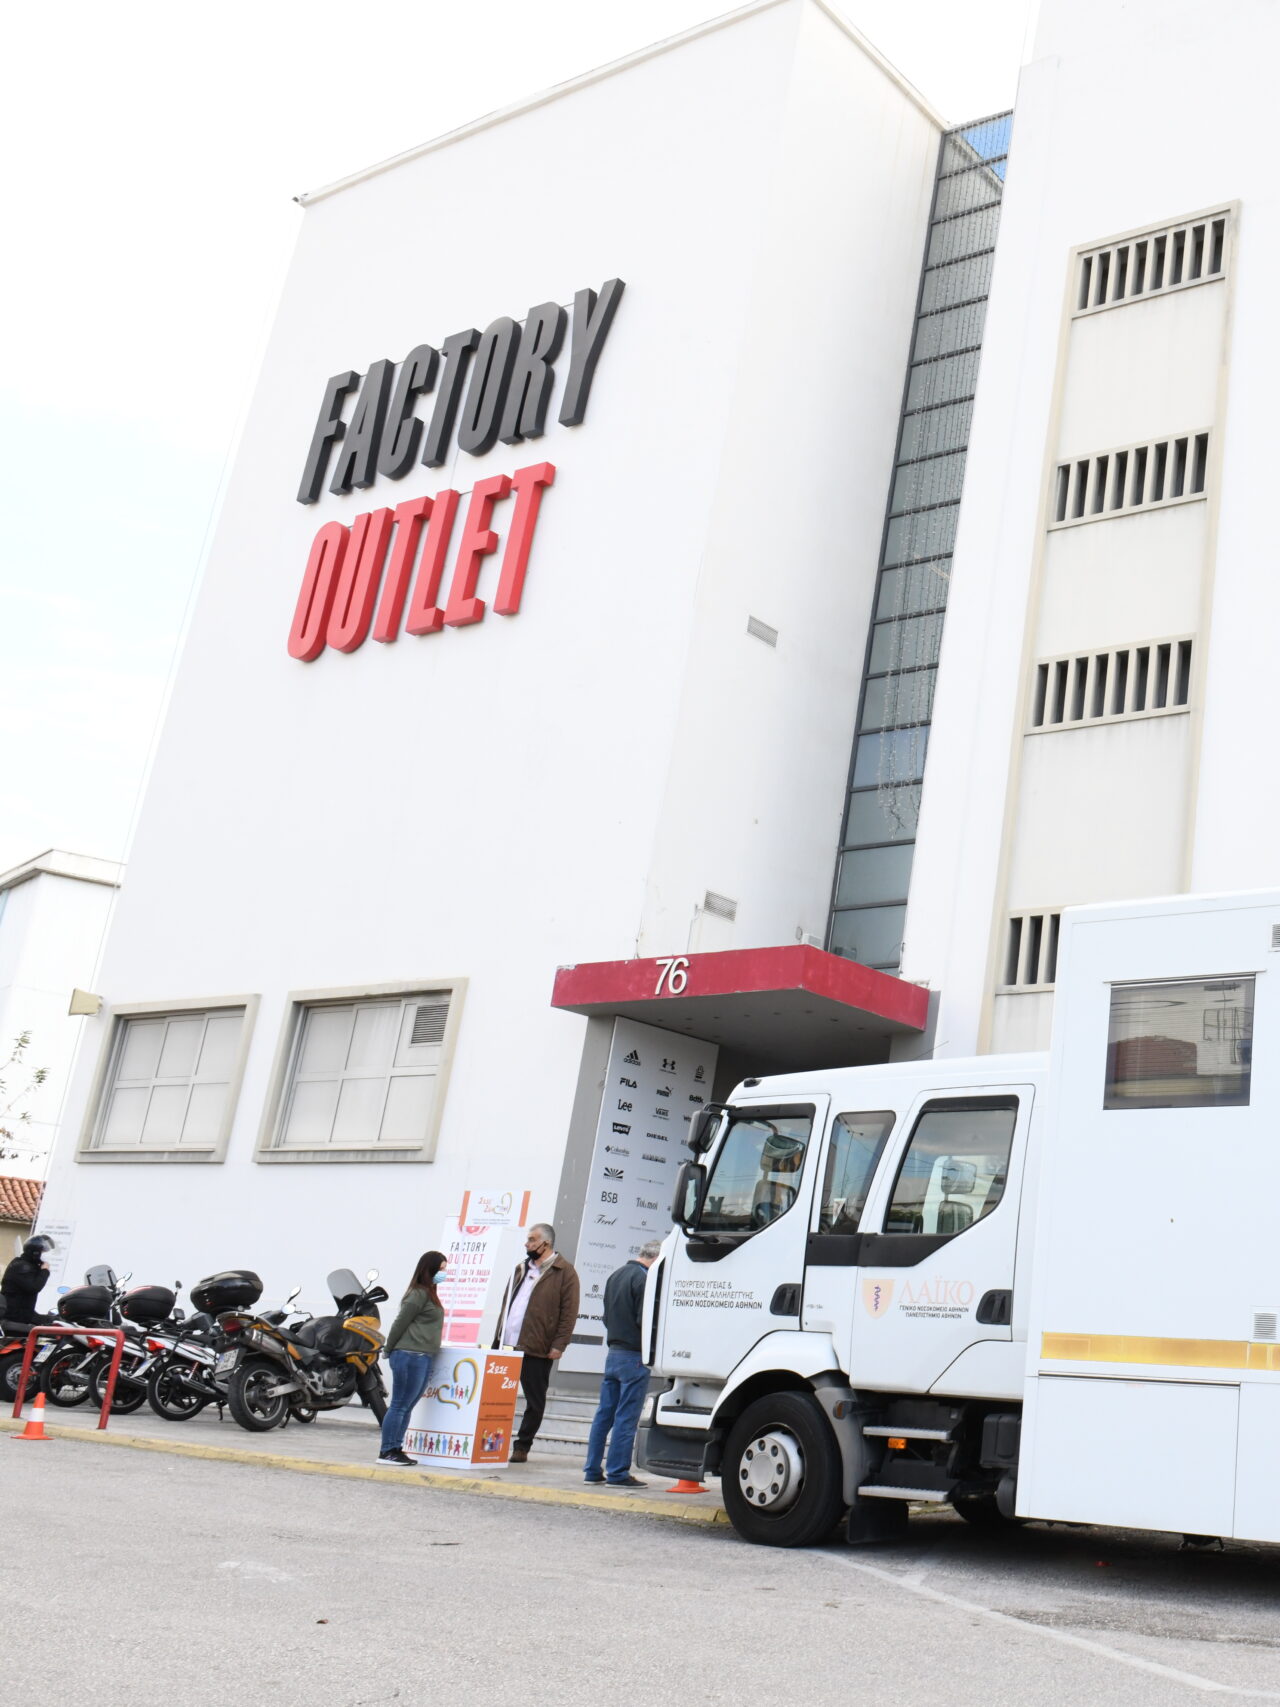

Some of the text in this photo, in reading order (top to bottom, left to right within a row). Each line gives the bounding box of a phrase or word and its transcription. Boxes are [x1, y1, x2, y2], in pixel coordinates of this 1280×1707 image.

[297, 277, 626, 505] FACTORY
[287, 462, 556, 663] OUTLET
[654, 957, 690, 995] 76
[619, 1077, 638, 1089] FILA
[618, 1098, 633, 1113] Lee
[646, 1132, 669, 1142] DIESEL
[601, 1191, 618, 1204] BSB
[447, 1253, 485, 1265] OUTLET
[674, 1280, 705, 1289] ΥΠΟΥΡΓΕΙΟ
[706, 1281, 727, 1289] ΥΓΕΙΑΣ
[898, 1275, 975, 1305] ΛΑΪΚΟ
[673, 1289, 754, 1300] ΚΟΙΝΩΝΙΚΗΣ ΑΛΛΗΛΕΓΓΥΗΣ
[672, 1299, 763, 1309] ΓΕΝΙΚΟ ΝΟΣΟΚΟΜΕΙΟ ΑΘΗΝΩΝ
